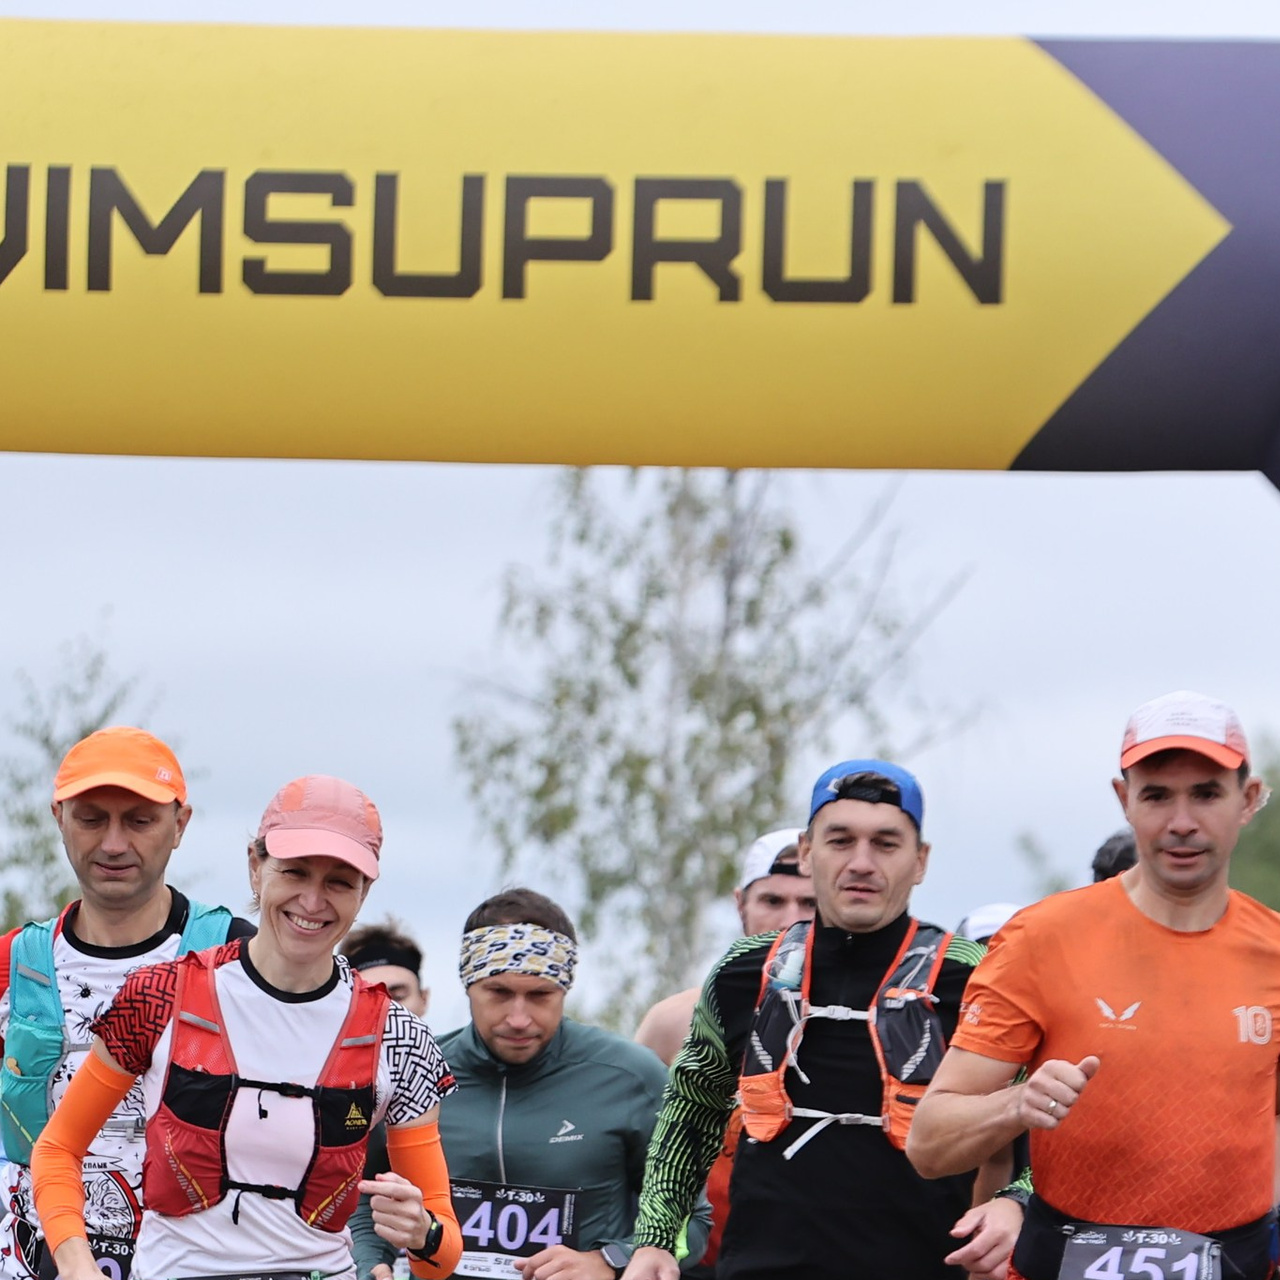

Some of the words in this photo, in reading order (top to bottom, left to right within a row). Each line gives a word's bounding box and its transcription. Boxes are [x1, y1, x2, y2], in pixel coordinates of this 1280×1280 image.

[1231, 1005, 1272, 1045] 10
[549, 1134, 584, 1143] DEMIX
[507, 1191, 534, 1203] T-30
[462, 1200, 562, 1250] 404
[1135, 1232, 1168, 1244] T-30
[99, 1242, 129, 1256] T-30
